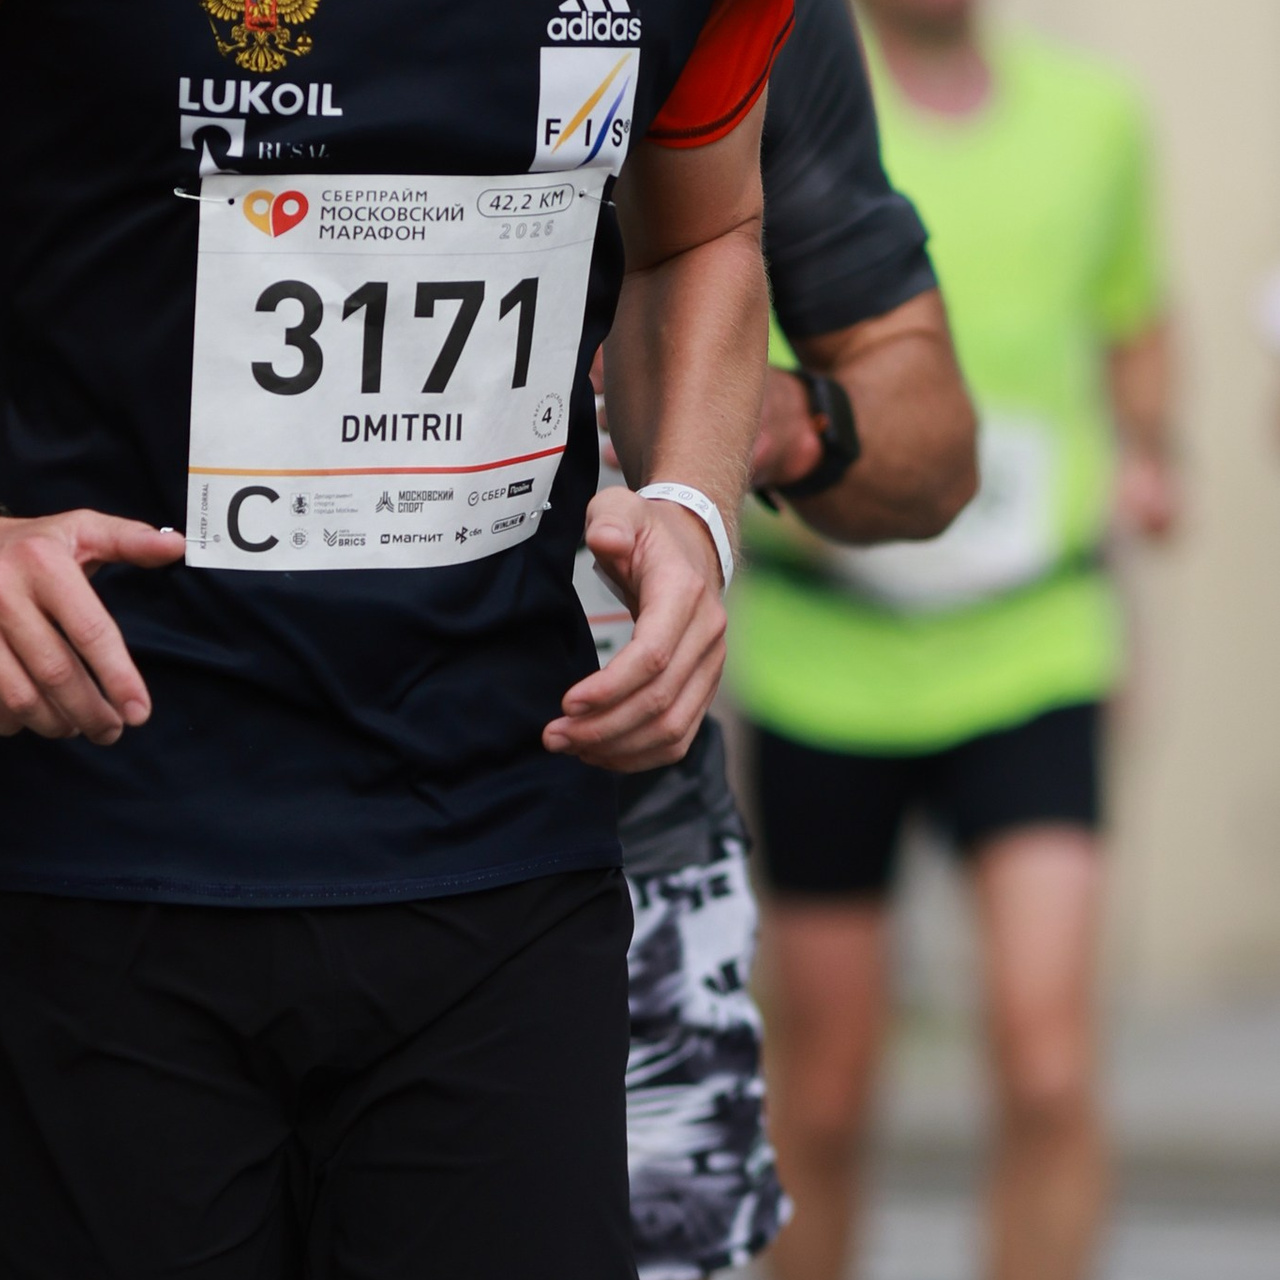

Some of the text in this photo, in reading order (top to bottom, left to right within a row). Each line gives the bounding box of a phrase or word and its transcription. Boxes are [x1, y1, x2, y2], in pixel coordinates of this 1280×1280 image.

[547, 11, 642, 41] adidas
[179, 77, 343, 116] LUKOIL
[322, 188, 428, 202] СБЕРПРАЙМ
[489, 194, 532, 212] 42,2
[320, 203, 464, 221] МОСКОВСКИЙ
[319, 224, 426, 240] МАРАФОН
[499, 220, 554, 239] 2026
[250, 276, 540, 396] 3171
[541, 406, 552, 423] 4
[341, 413, 463, 443] DMITRII
[398, 487, 454, 501] МОСКОВСКИЙ
[482, 487, 506, 502] СБЕР
[398, 502, 424, 513] СПОРТ
[227, 485, 280, 552] C
[494, 516, 519, 531] WINLINE
[338, 538, 366, 546] BRICS
[392, 533, 444, 544] магнит
